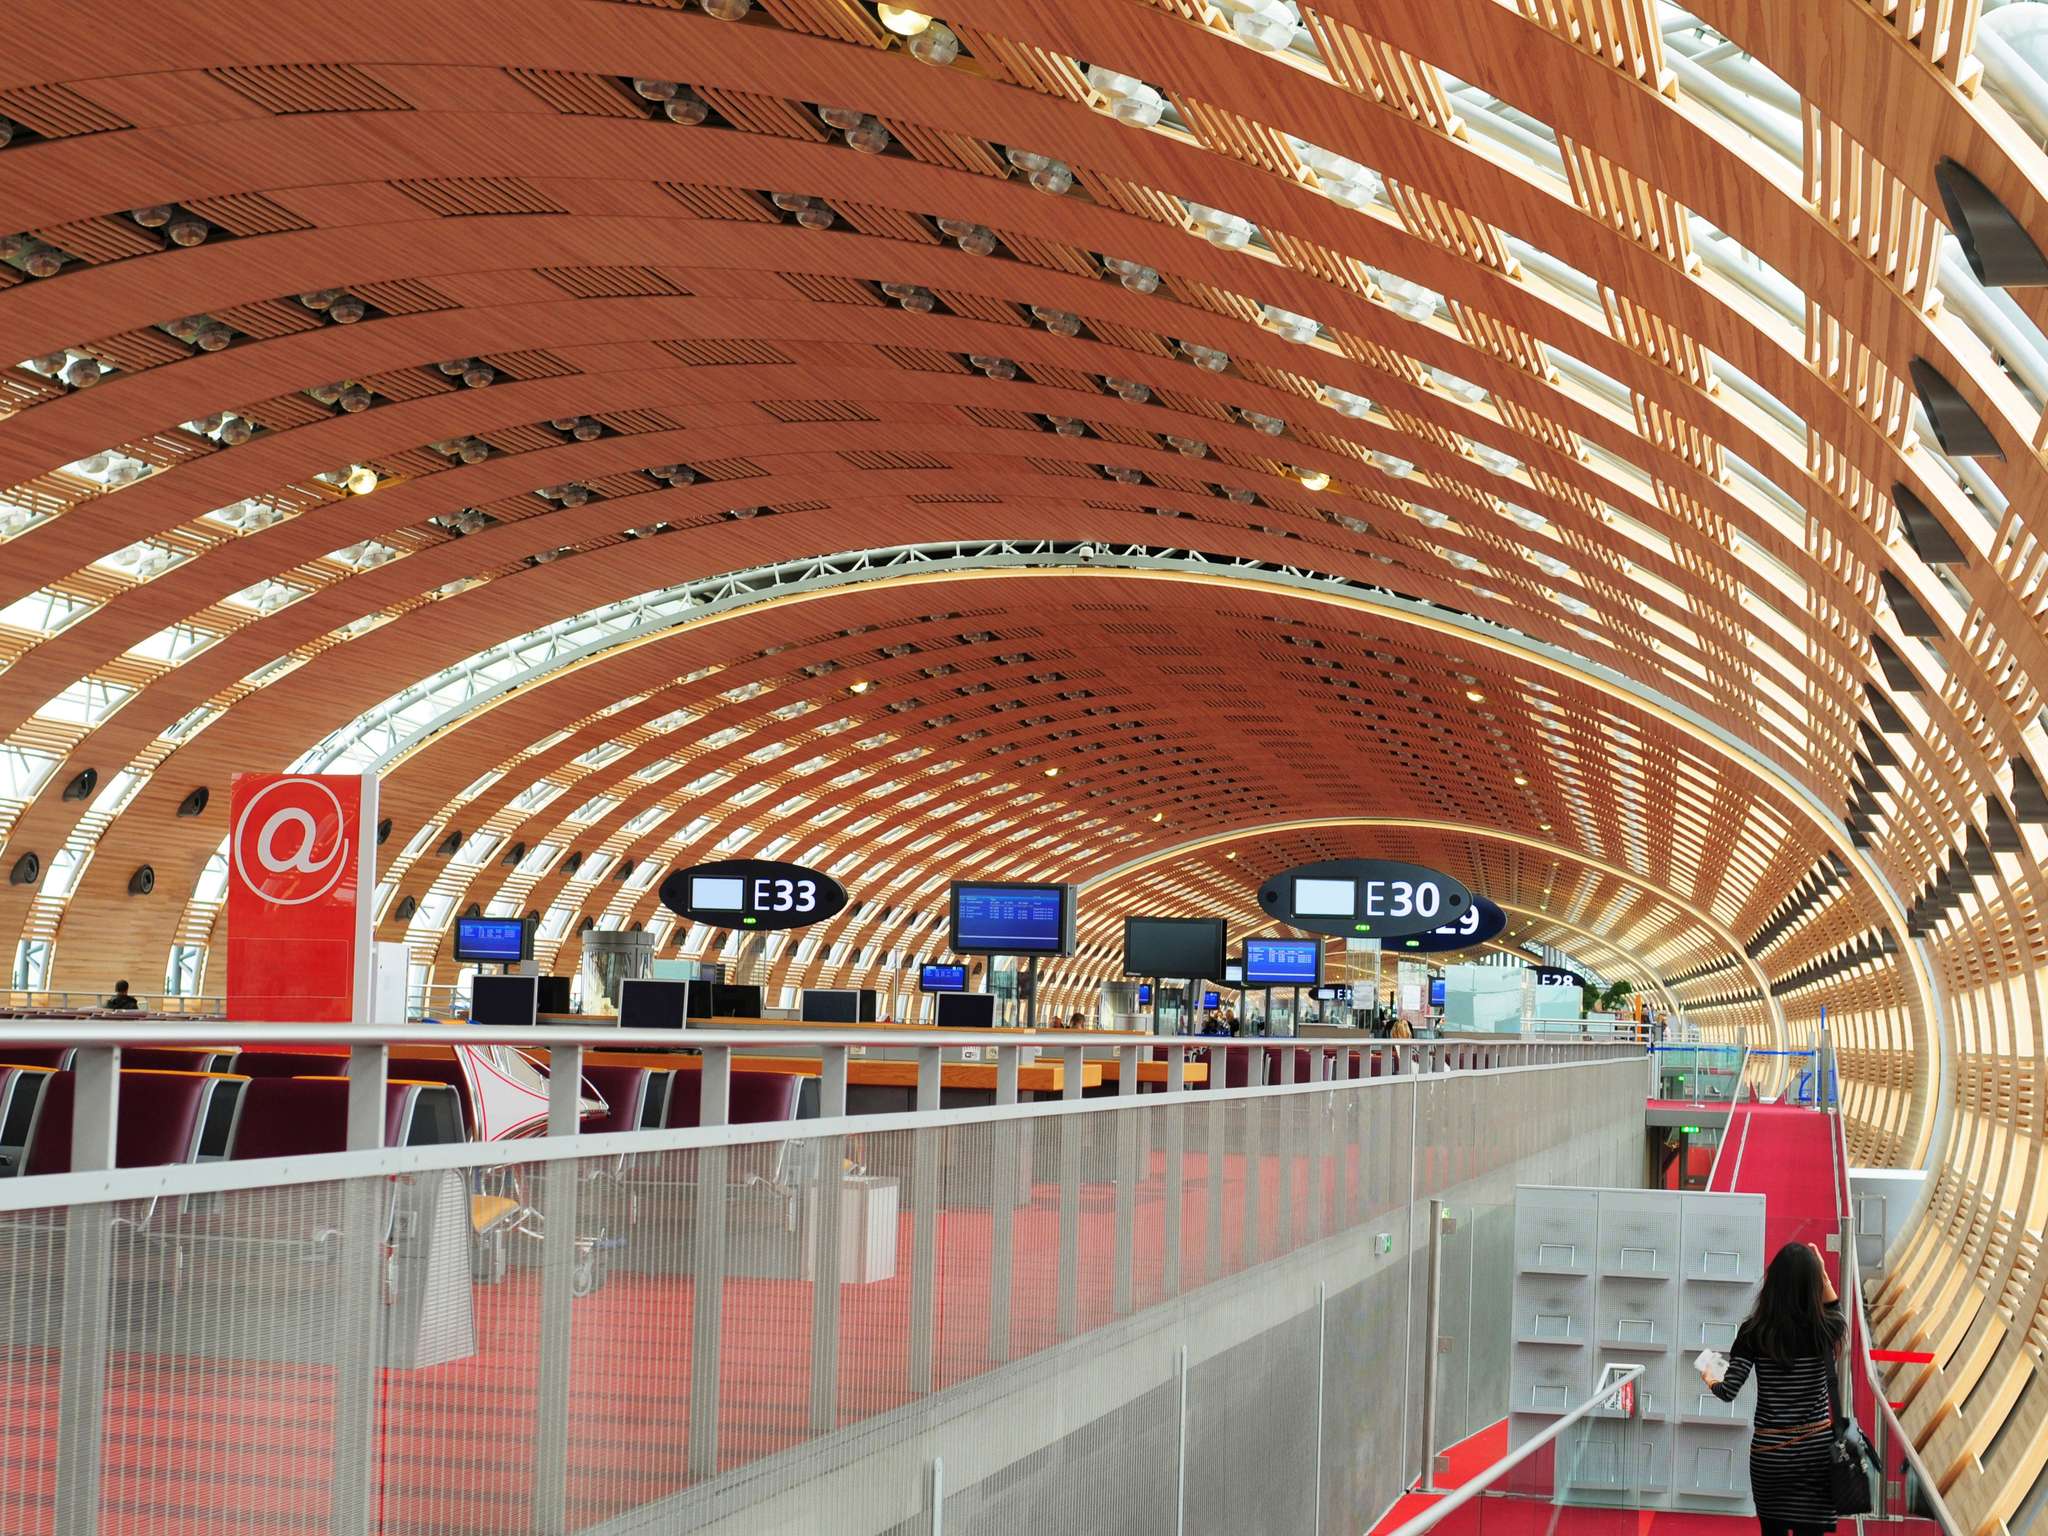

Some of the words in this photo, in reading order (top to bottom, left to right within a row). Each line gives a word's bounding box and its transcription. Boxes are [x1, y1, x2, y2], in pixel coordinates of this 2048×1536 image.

[234, 778, 349, 905] @
[754, 879, 816, 912] E33
[1366, 881, 1440, 918] E30
[1337, 988, 1355, 1000] E3
[1542, 974, 1574, 986] E28
